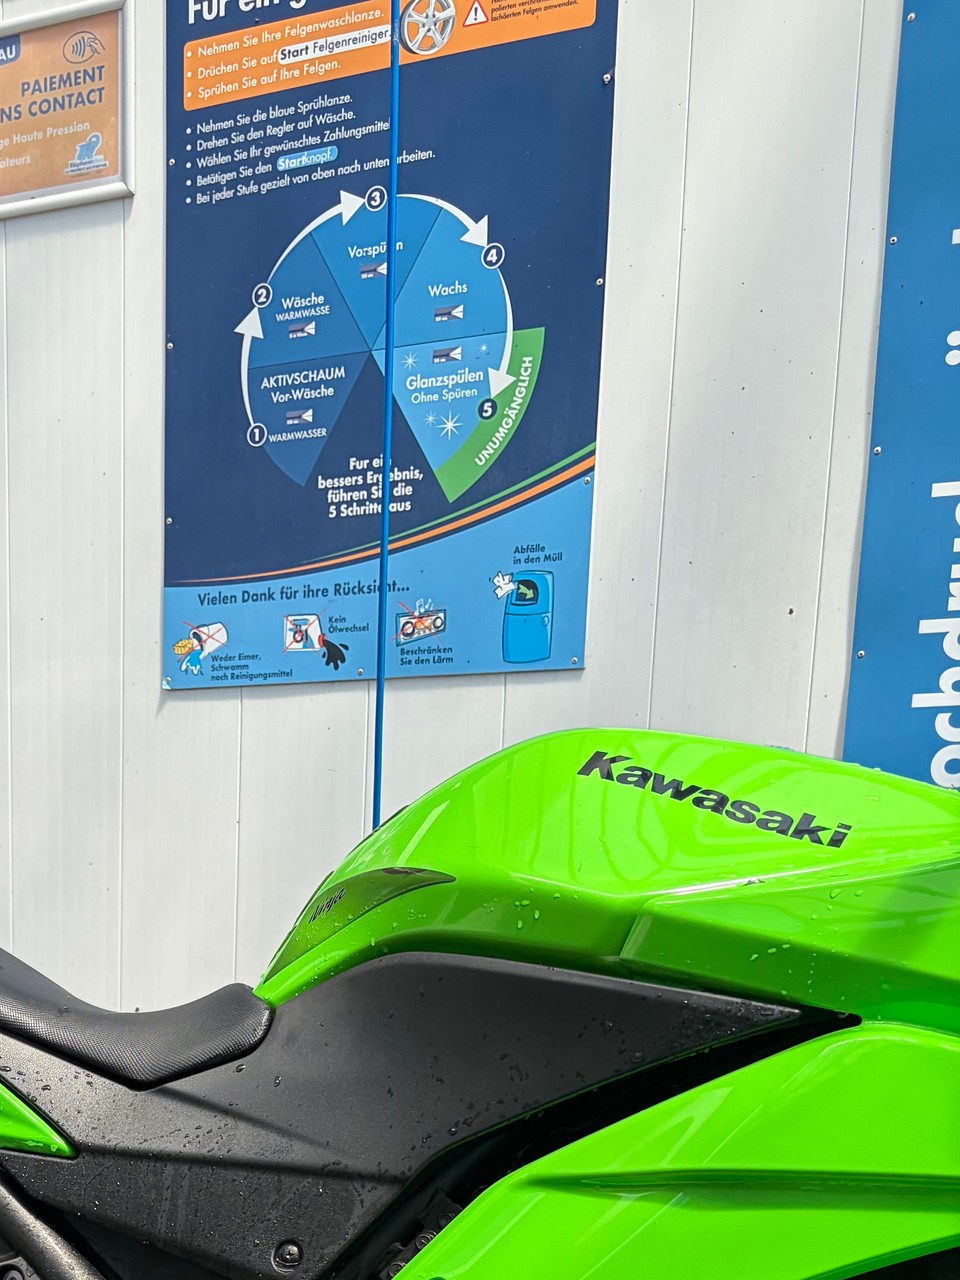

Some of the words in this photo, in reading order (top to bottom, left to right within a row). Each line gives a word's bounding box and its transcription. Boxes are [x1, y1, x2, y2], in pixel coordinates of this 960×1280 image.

[491, 3, 517, 13] polierten
[522, 7, 542, 15] Felgen
[198, 40, 240, 58] Nehmen
[243, 34, 259, 48] Sie
[262, 30, 282, 44] Ihre
[284, 8, 385, 40] Felgenwaschlanze.
[198, 62, 239, 80] Drüchen
[242, 56, 257, 69] Sie
[260, 51, 278, 64] auf
[280, 45, 309, 61] Start
[21, 65, 105, 98] PAIEMENT
[198, 82, 239, 101] Sprühen
[242, 76, 257, 89] Sie
[260, 70, 278, 84] auf
[280, 66, 300, 80] Ihre
[303, 59, 341, 77] Felgen.
[28, 86, 105, 117] CONTACT
[196, 119, 234, 135] Nehmen
[236, 114, 251, 126] Sie
[252, 111, 267, 123] die
[269, 105, 295, 120] blaue
[297, 93, 353, 115] Sprühlanze.
[13, 129, 43, 145] Haute
[46, 121, 90, 138] Pression
[196, 137, 229, 152] Drehen
[230, 132, 245, 144] Sie
[247, 128, 264, 141] den
[266, 122, 295, 138] Regler
[297, 117, 314, 130] auf
[315, 109, 356, 127] Wäsche.
[196, 153, 232, 169] Wählen
[233, 147, 248, 160] Sie
[249, 145, 262, 158] Ihr
[264, 134, 321, 159] gewünschtes
[196, 169, 237, 188] Betätigen
[239, 165, 253, 178] Sie
[255, 162, 272, 174] den
[278, 149, 334, 170] Startknopf.
[196, 192, 211, 205] Bei
[212, 187, 235, 204] jeder
[236, 181, 259, 196] Stufe
[260, 175, 290, 194] gezielt
[292, 173, 309, 185] von
[311, 167, 335, 181] oben
[337, 162, 361, 176] nach
[363, 157, 390, 172] unten
[371, 191, 381, 206] 3
[486, 249, 498, 263] 4
[258, 289, 267, 303] 2
[428, 280, 468, 297] Wachs
[281, 292, 325, 310] Wäsche
[275, 305, 330, 322] WARMWASSE
[260, 366, 346, 390] AKTIVSCHAUM
[405, 368, 484, 391] Glanzspülen
[270, 384, 335, 404] Vor-Wäsche
[410, 391, 439, 404] Ohne
[442, 388, 478, 403] Spüren
[474, 356, 533, 466] UNUMGÄNGLICH
[482, 402, 493, 417] 5
[253, 428, 260, 442] 1
[268, 428, 327, 443] WARMWASSER
[349, 457, 369, 471] Fur
[317, 472, 364, 489] bessers
[327, 490, 368, 503] führen
[393, 482, 413, 497] die
[328, 505, 337, 518] 5
[389, 501, 411, 512] aus
[513, 543, 546, 555] Abfälle
[513, 557, 521, 565] in
[524, 555, 541, 564] den
[543, 552, 563, 563] Müll
[198, 591, 237, 607] Vielen
[241, 587, 276, 603] Dank
[279, 586, 300, 601] für
[303, 583, 329, 599] ihre
[328, 616, 347, 624] Kein
[328, 623, 370, 634] Ölwechsel
[211, 653, 236, 663] Weder
[238, 652, 262, 662] Eimer,
[400, 646, 453, 656] Beschränken
[211, 663, 249, 672] Schwamm
[399, 657, 412, 666] Sie
[414, 656, 430, 665] den
[432, 655, 454, 665] Lärm
[211, 672, 229, 682] noch
[230, 669, 293, 681] Reinigungsmittel
[577, 751, 852, 848] Kawasaki
